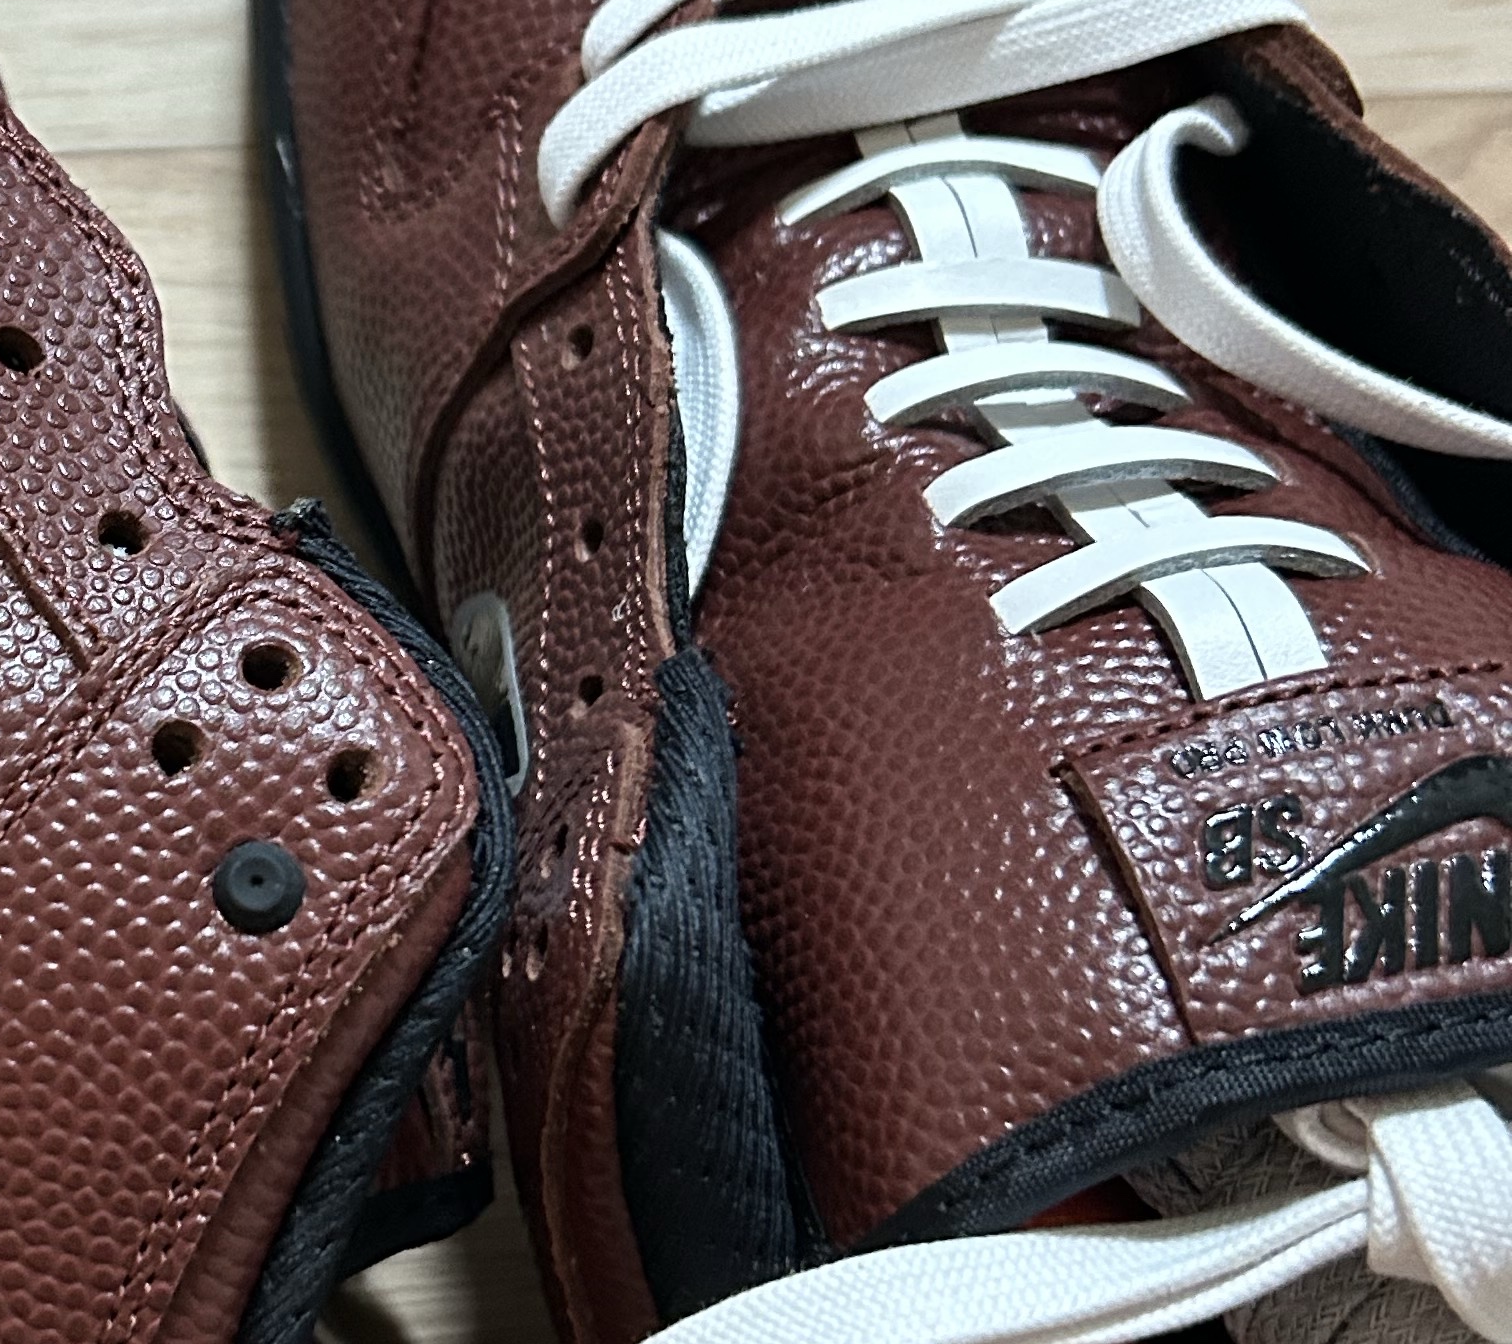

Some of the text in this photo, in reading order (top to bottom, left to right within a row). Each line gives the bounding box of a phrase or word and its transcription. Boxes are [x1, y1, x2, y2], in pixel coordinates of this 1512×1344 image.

[1171, 737, 1249, 779] PRO
[1258, 717, 1345, 758] LOW
[1202, 793, 1306, 891] SB
[1293, 847, 1511, 994] NIKE
